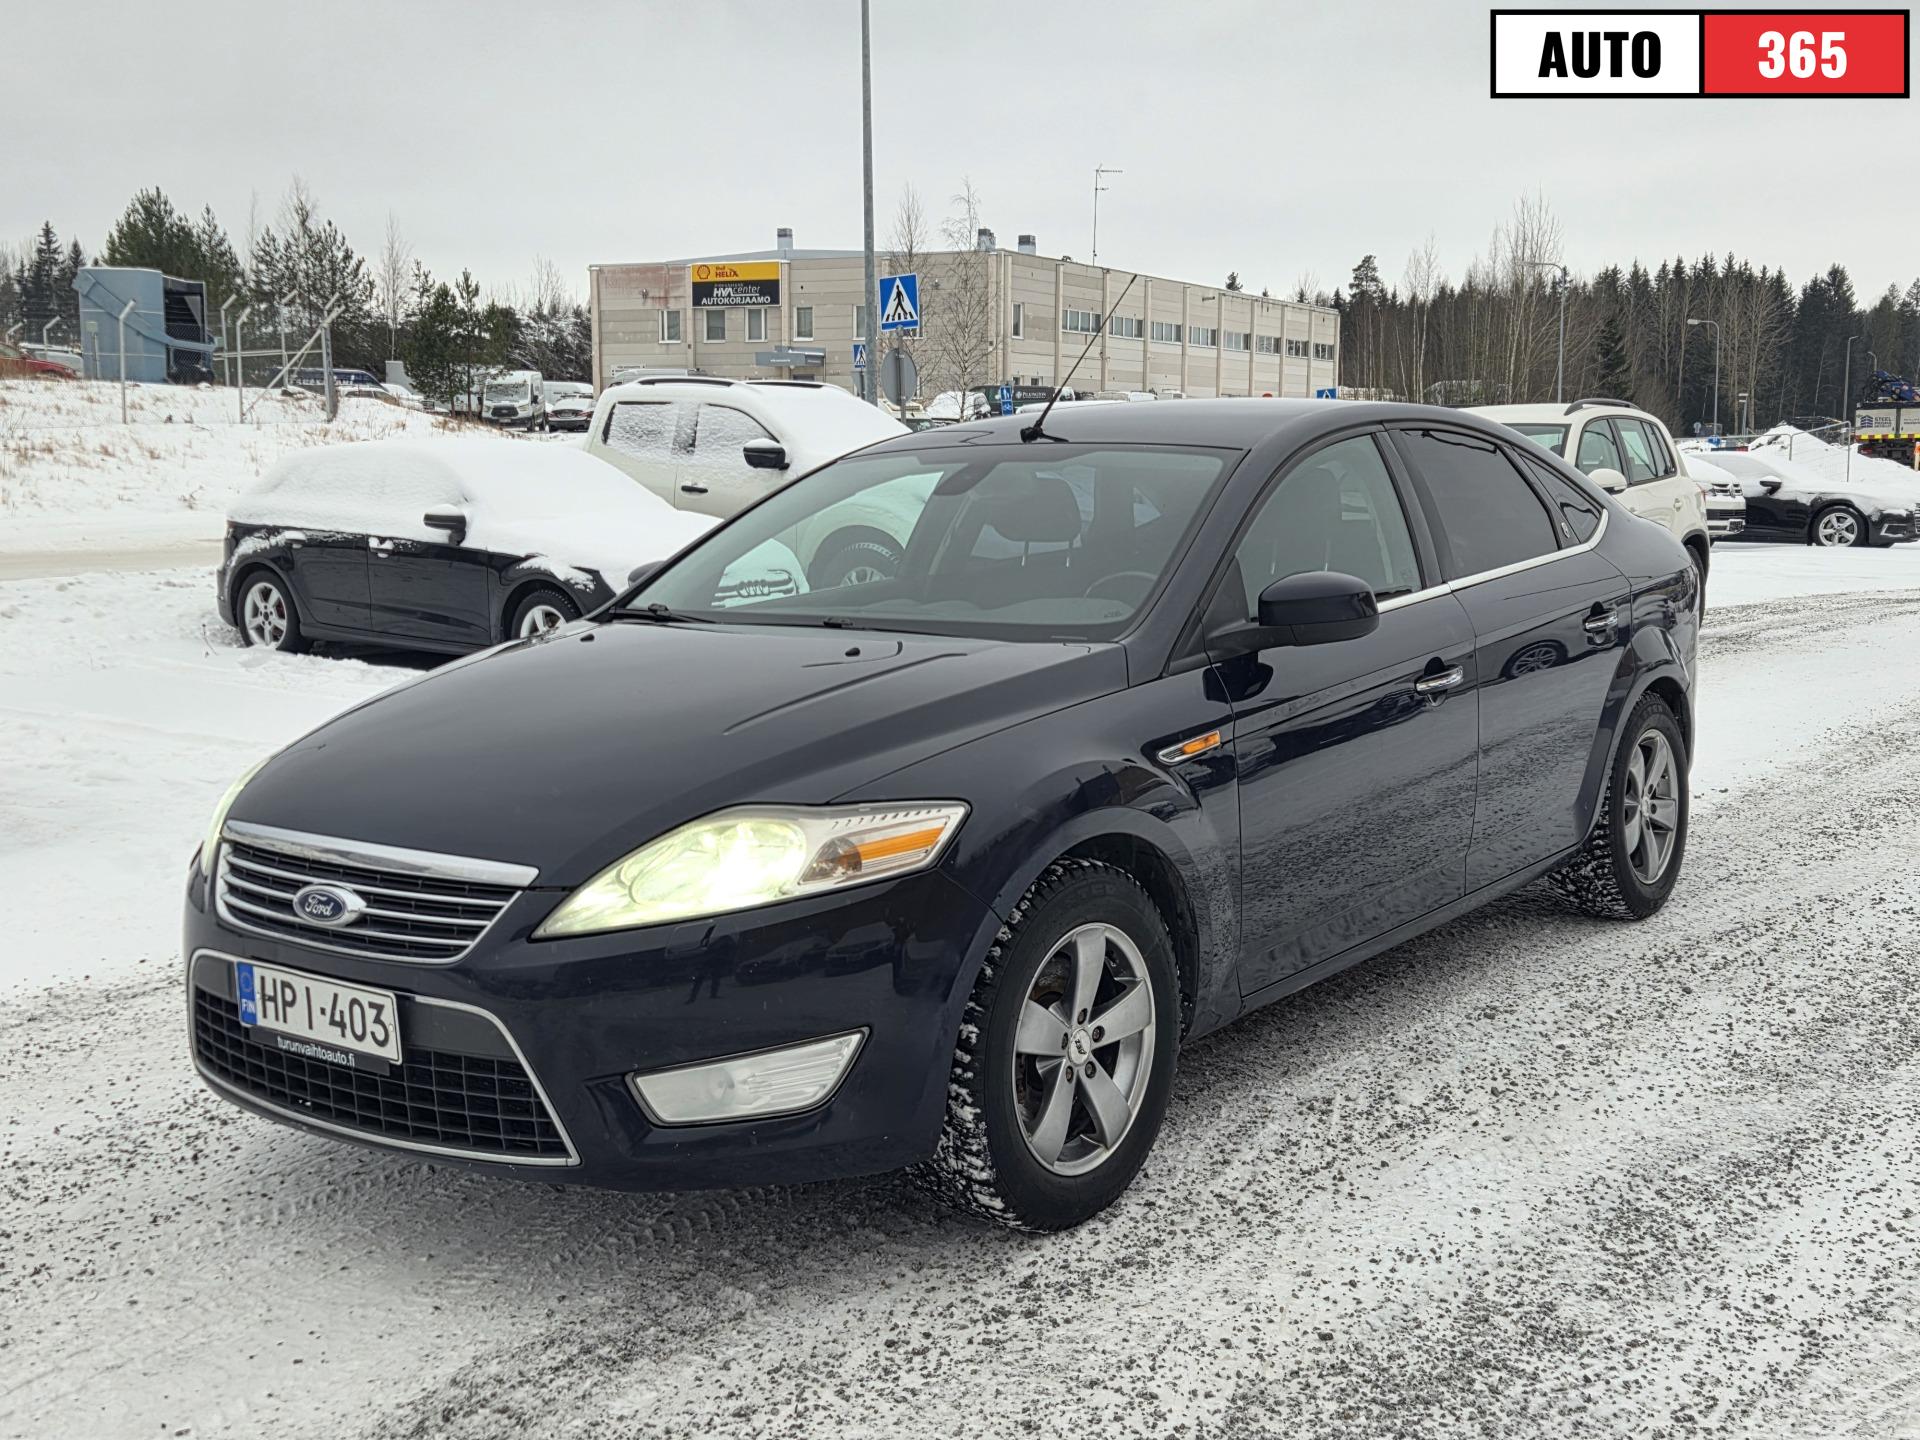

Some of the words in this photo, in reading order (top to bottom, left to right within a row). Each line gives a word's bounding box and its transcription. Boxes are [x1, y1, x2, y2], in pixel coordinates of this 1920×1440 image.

[715, 269, 739, 278] HELIX
[701, 296, 771, 305] AUTOKORJAAMO
[305, 893, 334, 916] Ford
[241, 998, 256, 1014] FIN
[260, 975, 390, 1048] HPI-403
[277, 1035, 355, 1067] turunvaihtoauto.fi
